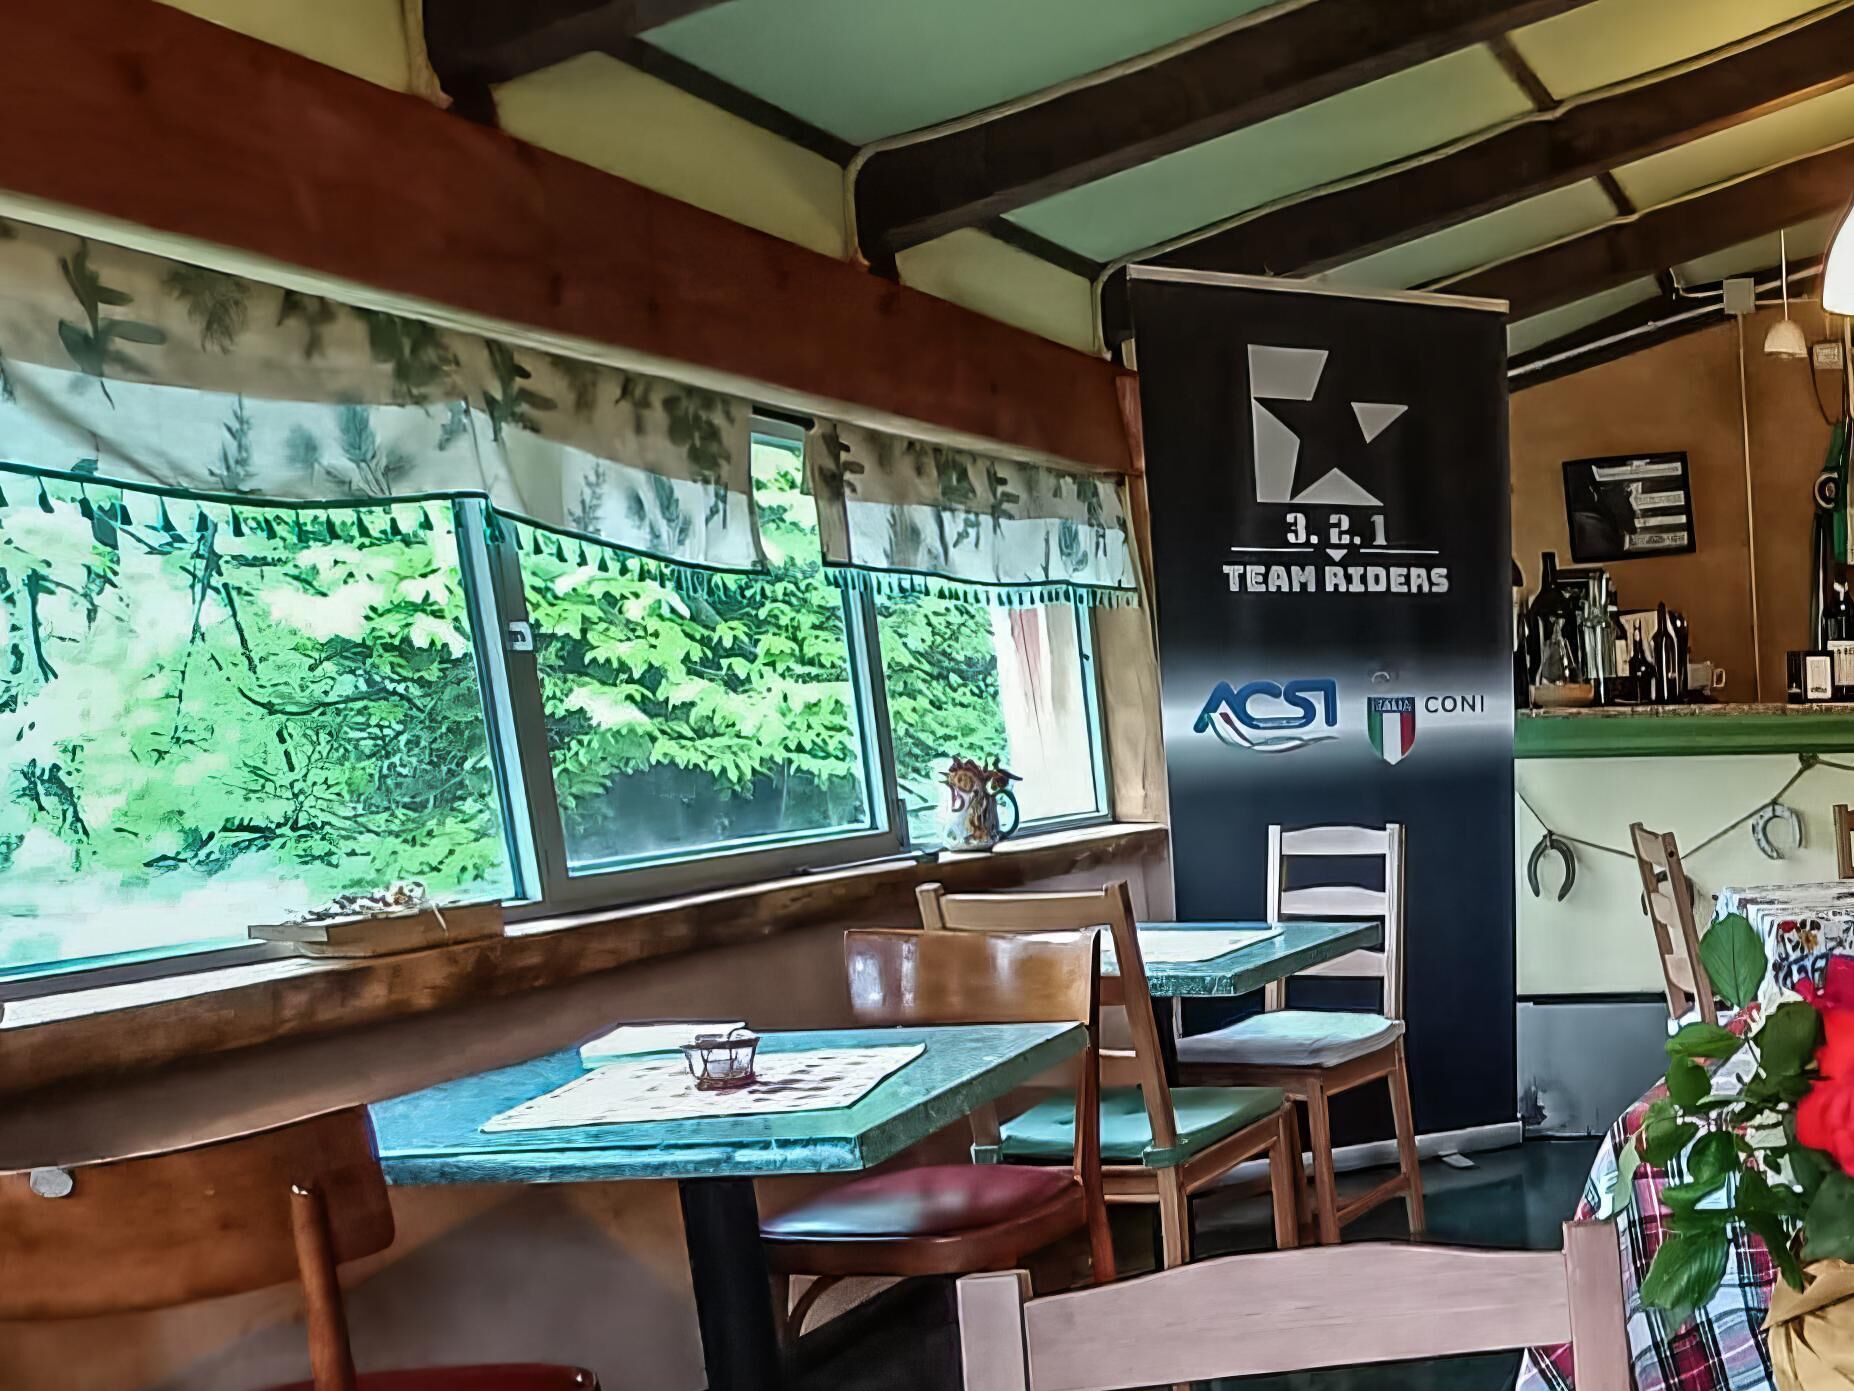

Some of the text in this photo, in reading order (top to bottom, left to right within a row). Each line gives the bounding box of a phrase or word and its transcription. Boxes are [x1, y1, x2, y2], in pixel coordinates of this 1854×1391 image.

[1222, 565, 1449, 593] TEAM RIDERS
[1193, 678, 1338, 734] ACSI
[1424, 694, 1485, 713] CONI
